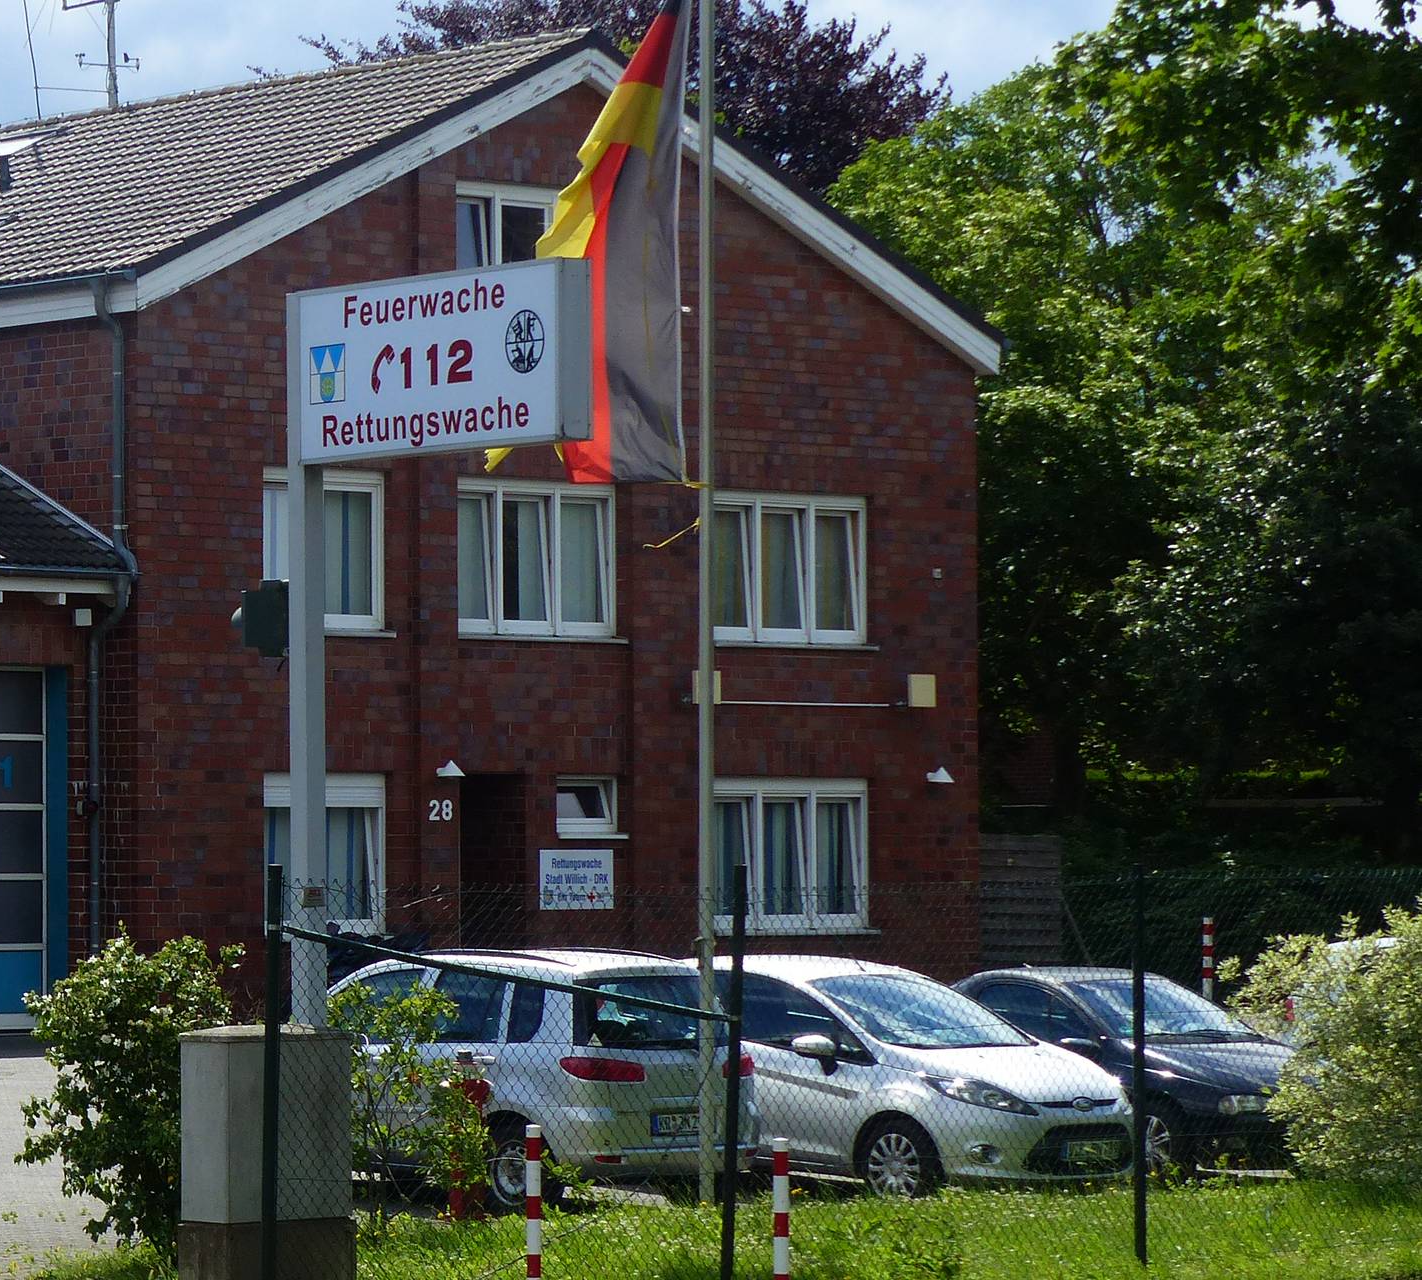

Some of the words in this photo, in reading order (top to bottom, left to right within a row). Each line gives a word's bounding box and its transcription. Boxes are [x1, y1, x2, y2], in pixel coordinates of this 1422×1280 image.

[344, 278, 505, 328] Feuerwache
[400, 339, 473, 389] 112
[322, 396, 529, 447] Rettungswache
[429, 799, 453, 821] 28
[545, 873, 563, 884] Stadt
[564, 873, 588, 884] Willich
[594, 873, 609, 884] DRK
[551, 858, 603, 871] Rettungswache
